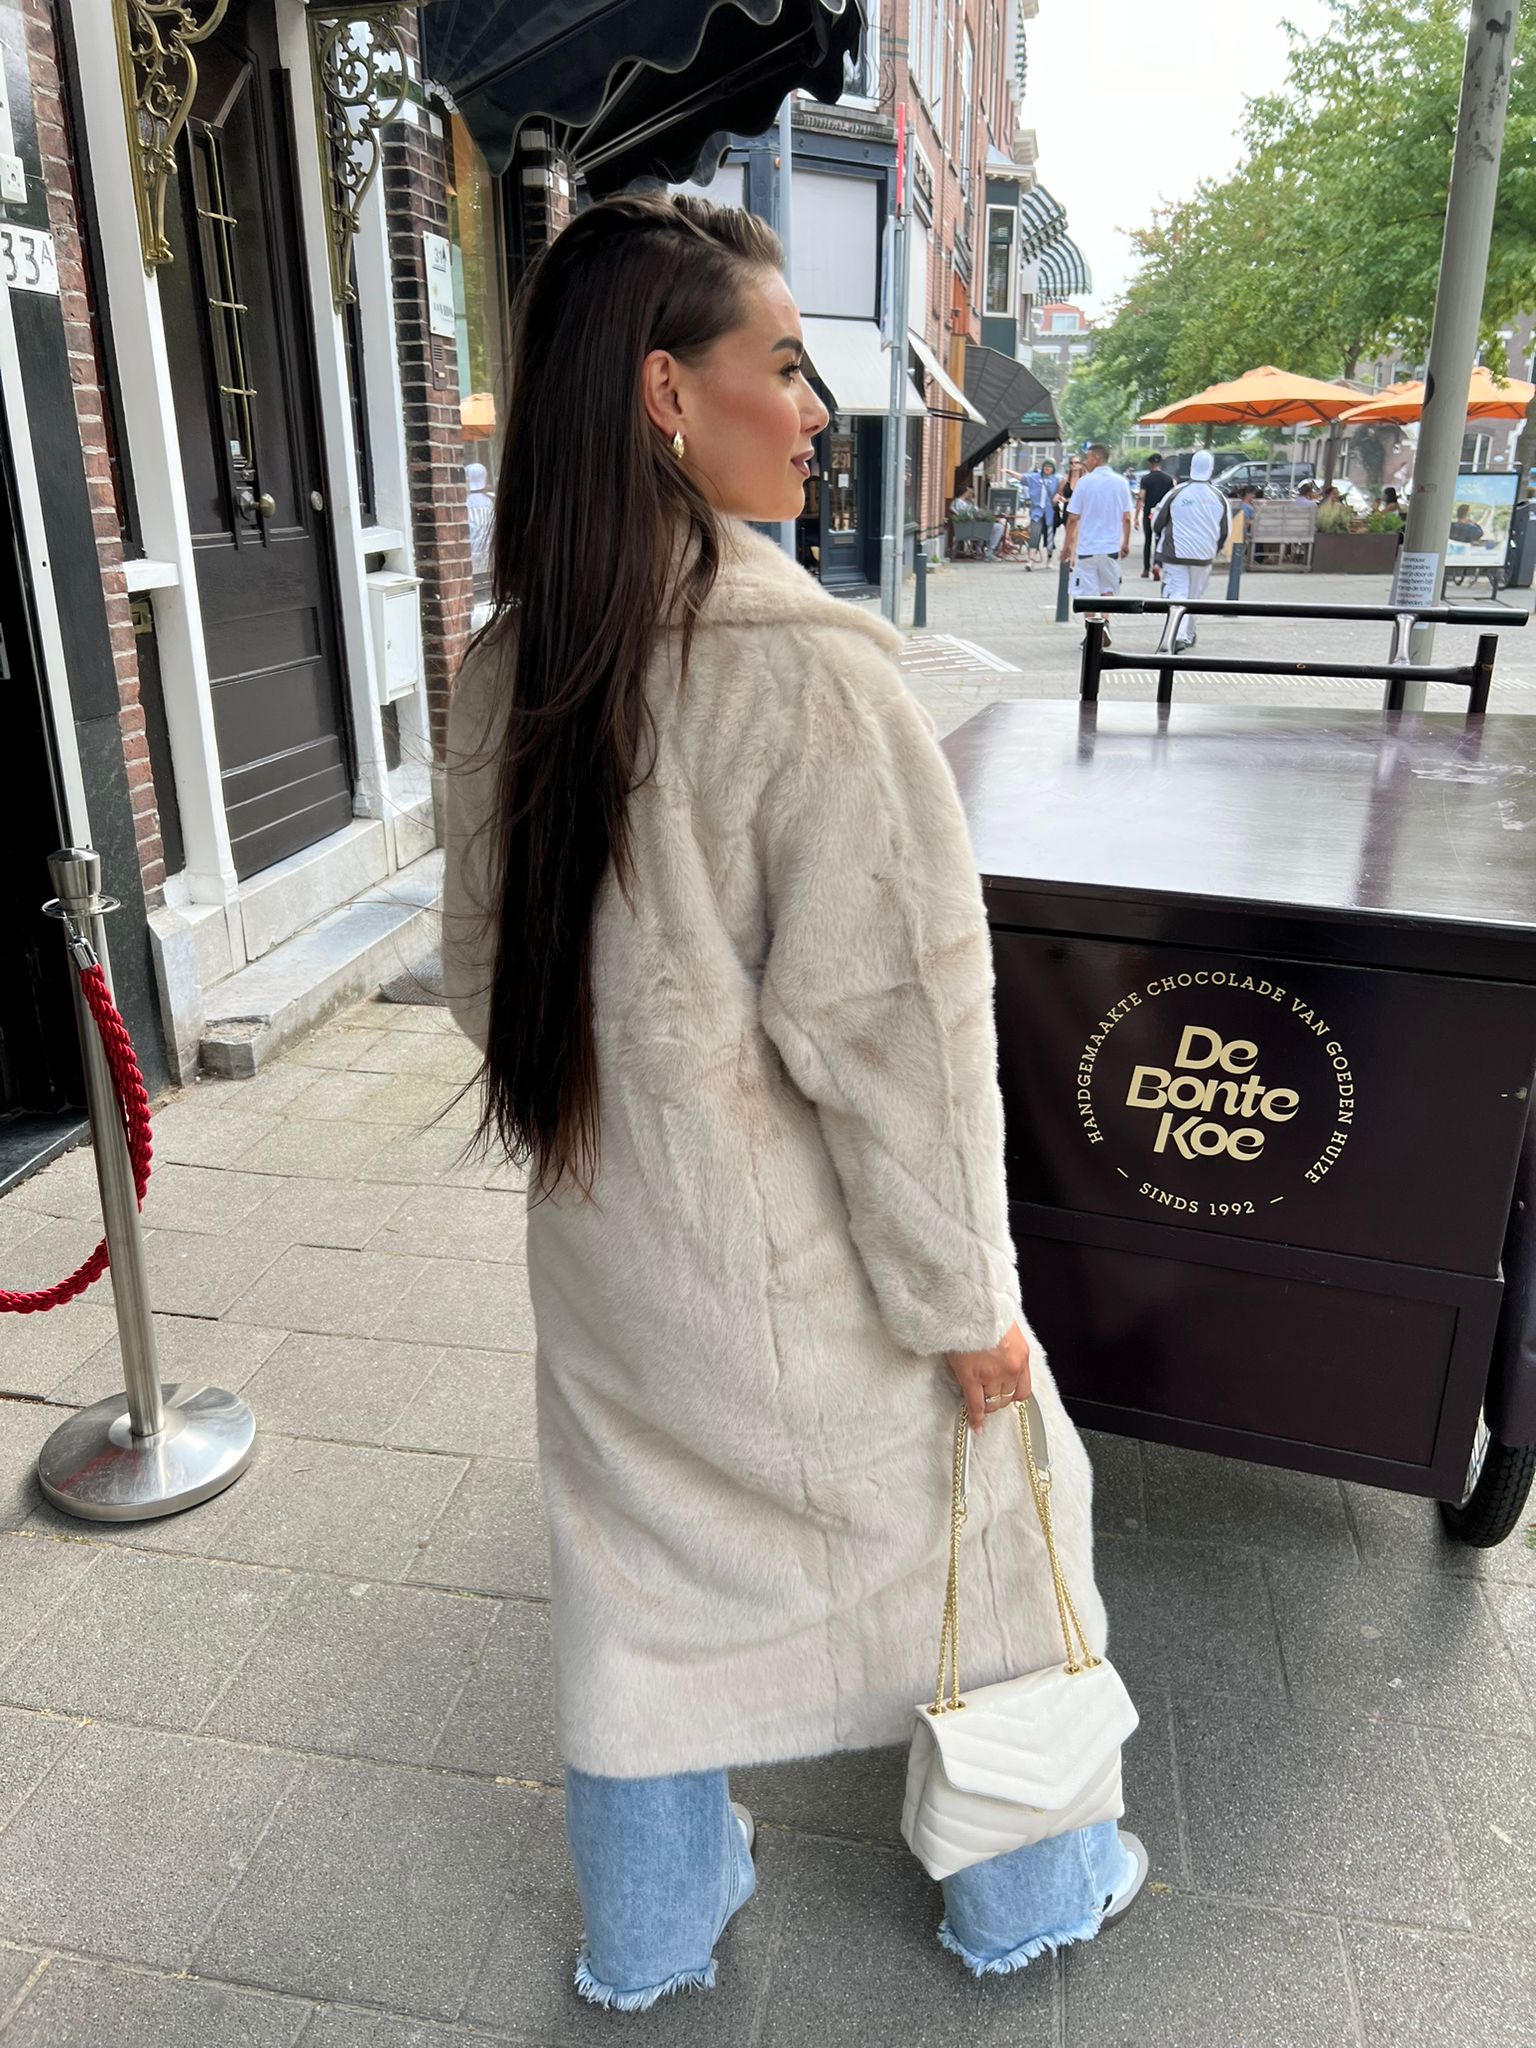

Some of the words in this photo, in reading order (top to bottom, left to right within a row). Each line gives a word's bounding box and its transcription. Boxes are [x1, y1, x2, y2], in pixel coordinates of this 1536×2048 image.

[1146, 971, 1286, 1003] CHOCOLADE
[1289, 997, 1330, 1037] VAN
[1077, 991, 1143, 1145] HANDGEMAAKTE
[1174, 1025, 1259, 1074] De
[1125, 1065, 1300, 1123] Bonte
[1325, 1041, 1356, 1125] GOEDEN
[1153, 1112, 1265, 1161] Koe
[1304, 1132, 1350, 1184] HUIZE
[1139, 1182, 1199, 1213] SINDS
[1209, 1200, 1256, 1216] 1992
